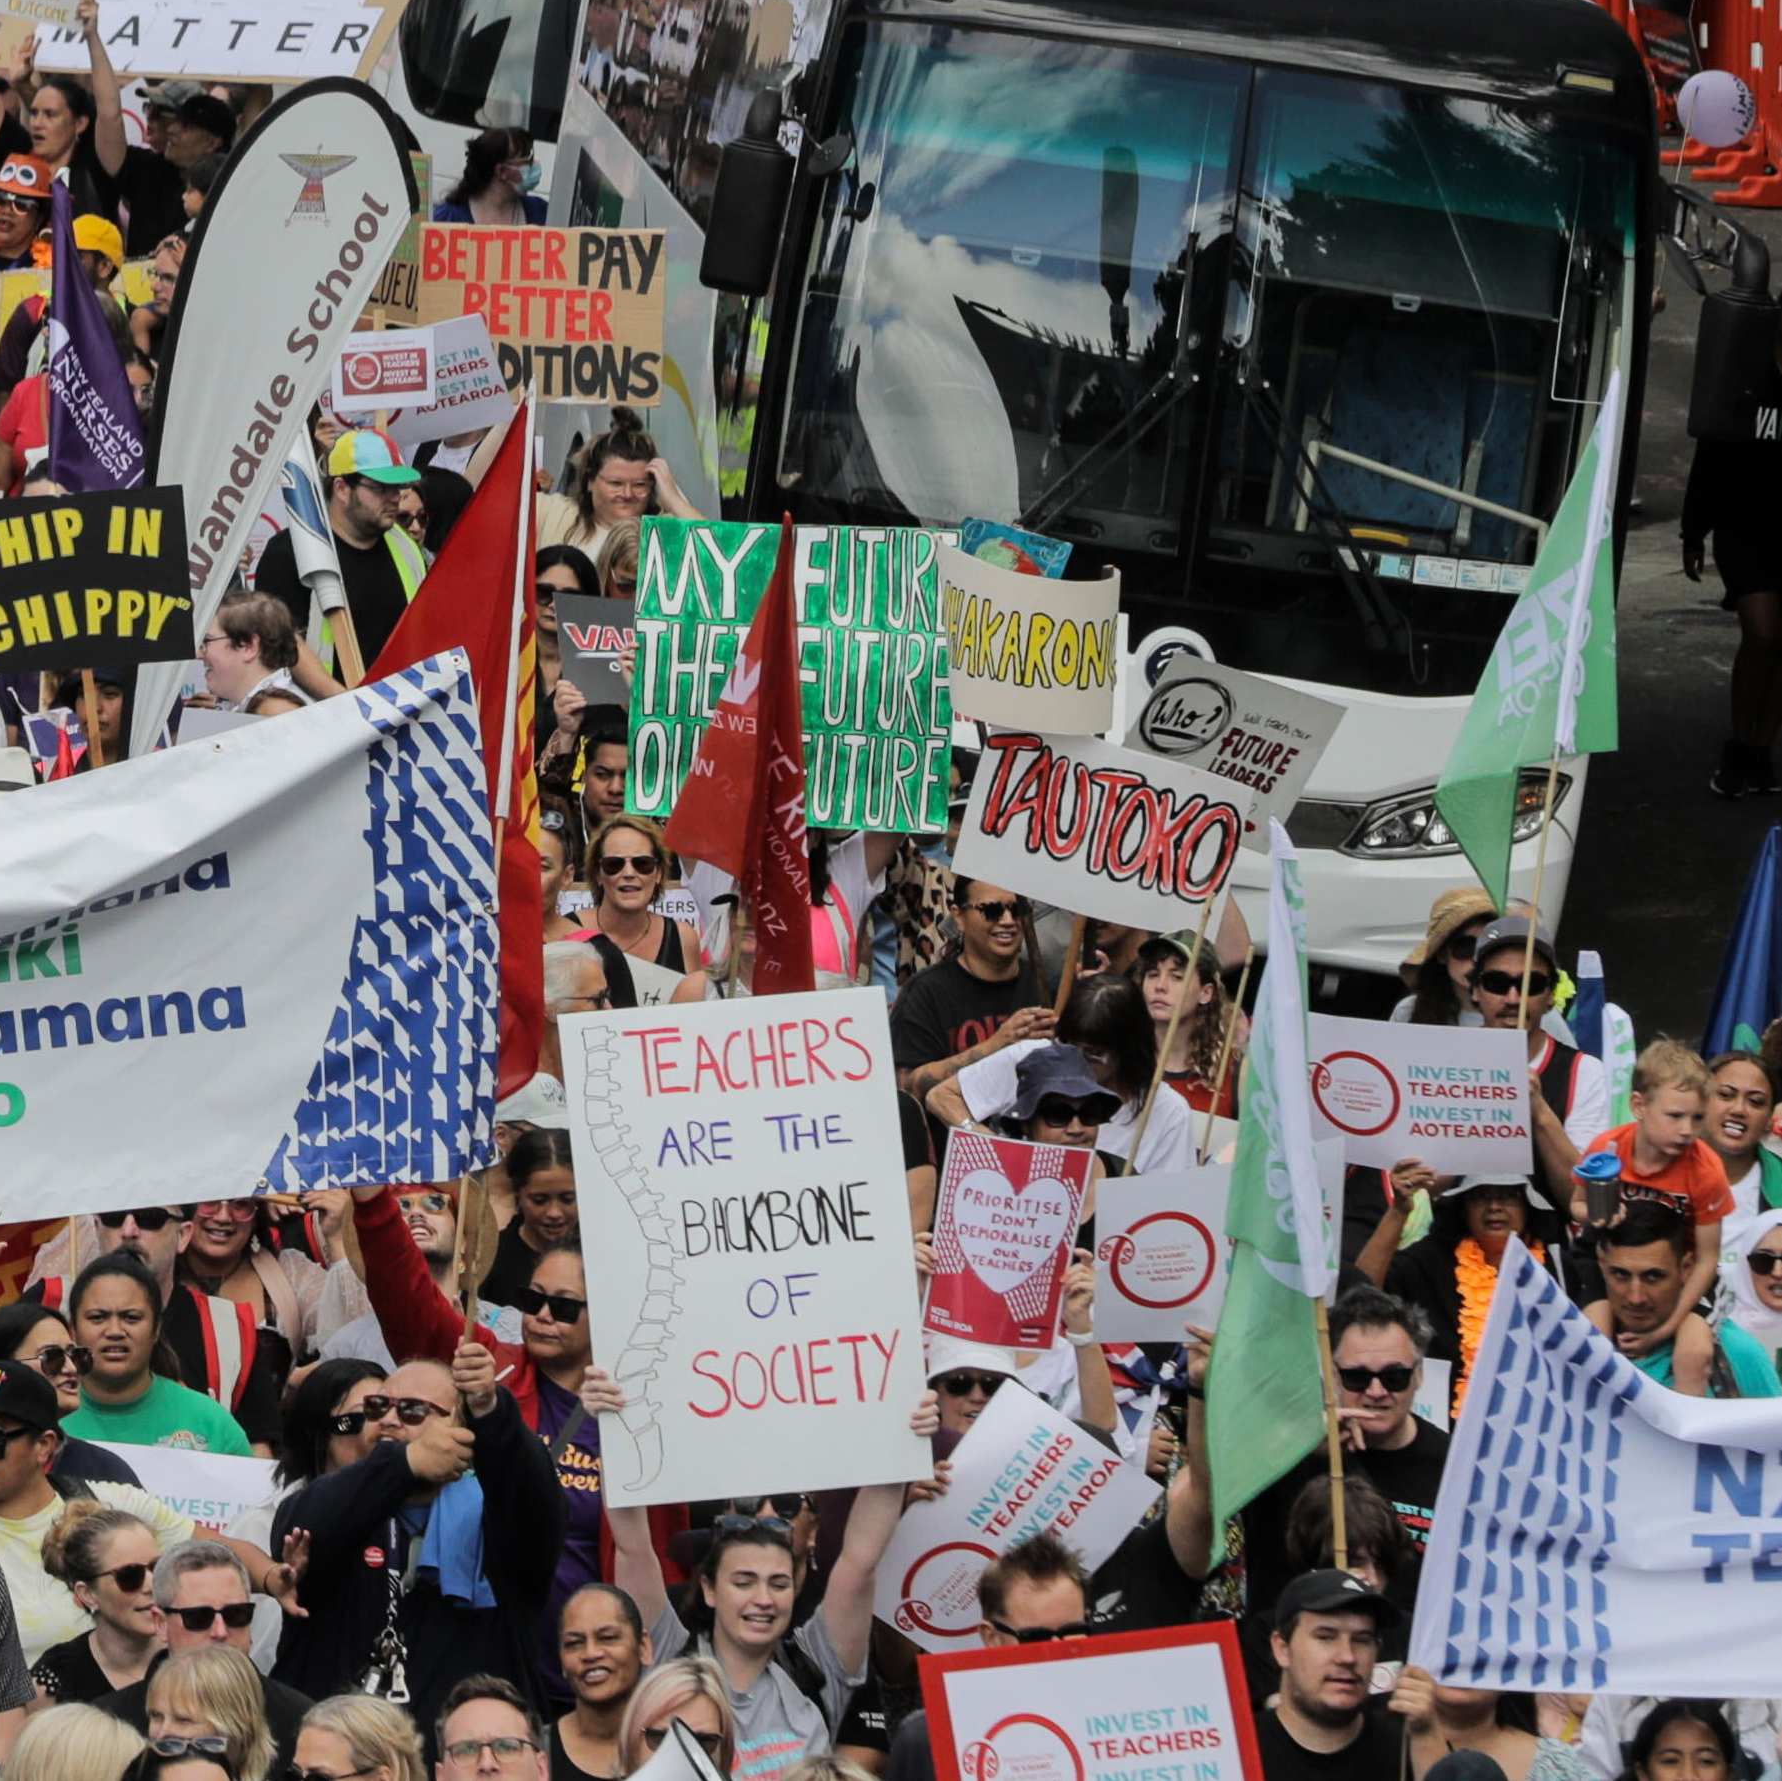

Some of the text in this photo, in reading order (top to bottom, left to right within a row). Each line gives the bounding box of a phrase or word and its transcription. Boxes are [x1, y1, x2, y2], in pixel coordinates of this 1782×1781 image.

[422, 231, 665, 294] BETTER PAY
[463, 288, 612, 342] BETTER
[49, 375, 123, 480] ORGANISATION
[54, 355, 133, 471] NURSES
[68, 345, 144, 458] NEW ZEALAND
[106, 503, 163, 558] IN
[1152, 697, 1223, 734] Who?
[1207, 757, 1277, 794] LEADERS
[1215, 727, 1300, 776] FUTURE
[981, 732, 1242, 905] TAUTOKO
[623, 1015, 873, 1099] TEACHERS
[657, 1113, 853, 1169] ARE THE
[682, 1181, 874, 1258] BACKBONE
[963, 1187, 1063, 1216] PRIORITISE
[959, 1223, 1052, 1249] DEMORALISE
[993, 1247, 1020, 1260] OUR
[971, 1255, 1034, 1273] TEACHERS
[746, 1272, 820, 1319] OF
[689, 1330, 900, 1419] SOCIETY
